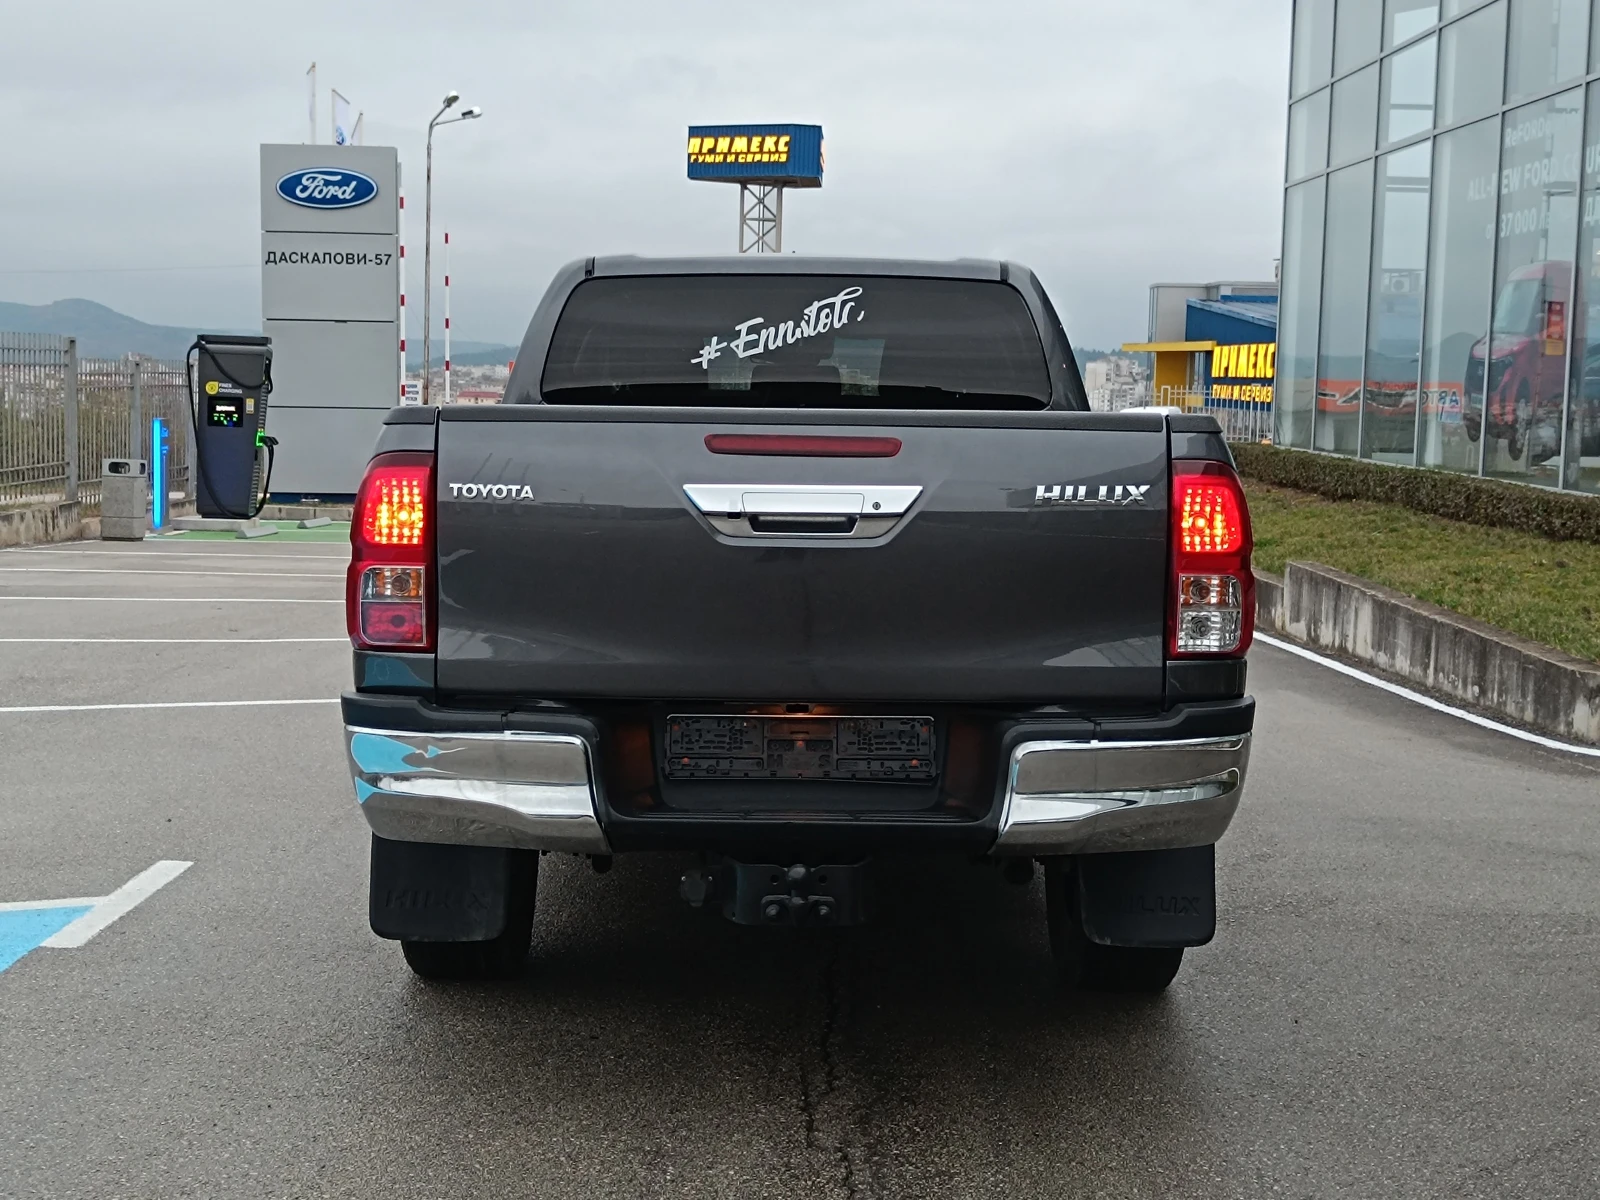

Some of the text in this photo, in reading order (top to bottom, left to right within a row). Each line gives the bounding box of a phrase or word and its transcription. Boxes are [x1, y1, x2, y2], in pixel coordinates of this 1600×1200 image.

[688, 135, 791, 154] ПРИМЕКС
[690, 153, 788, 163] ГУМИ И СЕРВИЗ
[296, 173, 357, 200] Ford
[265, 251, 392, 266] ДАСКАЛОВИ-57
[1211, 342, 1276, 378] ПРИМЕКС
[449, 483, 535, 501] TOYOTA
[1034, 484, 1151, 506] HILUX
